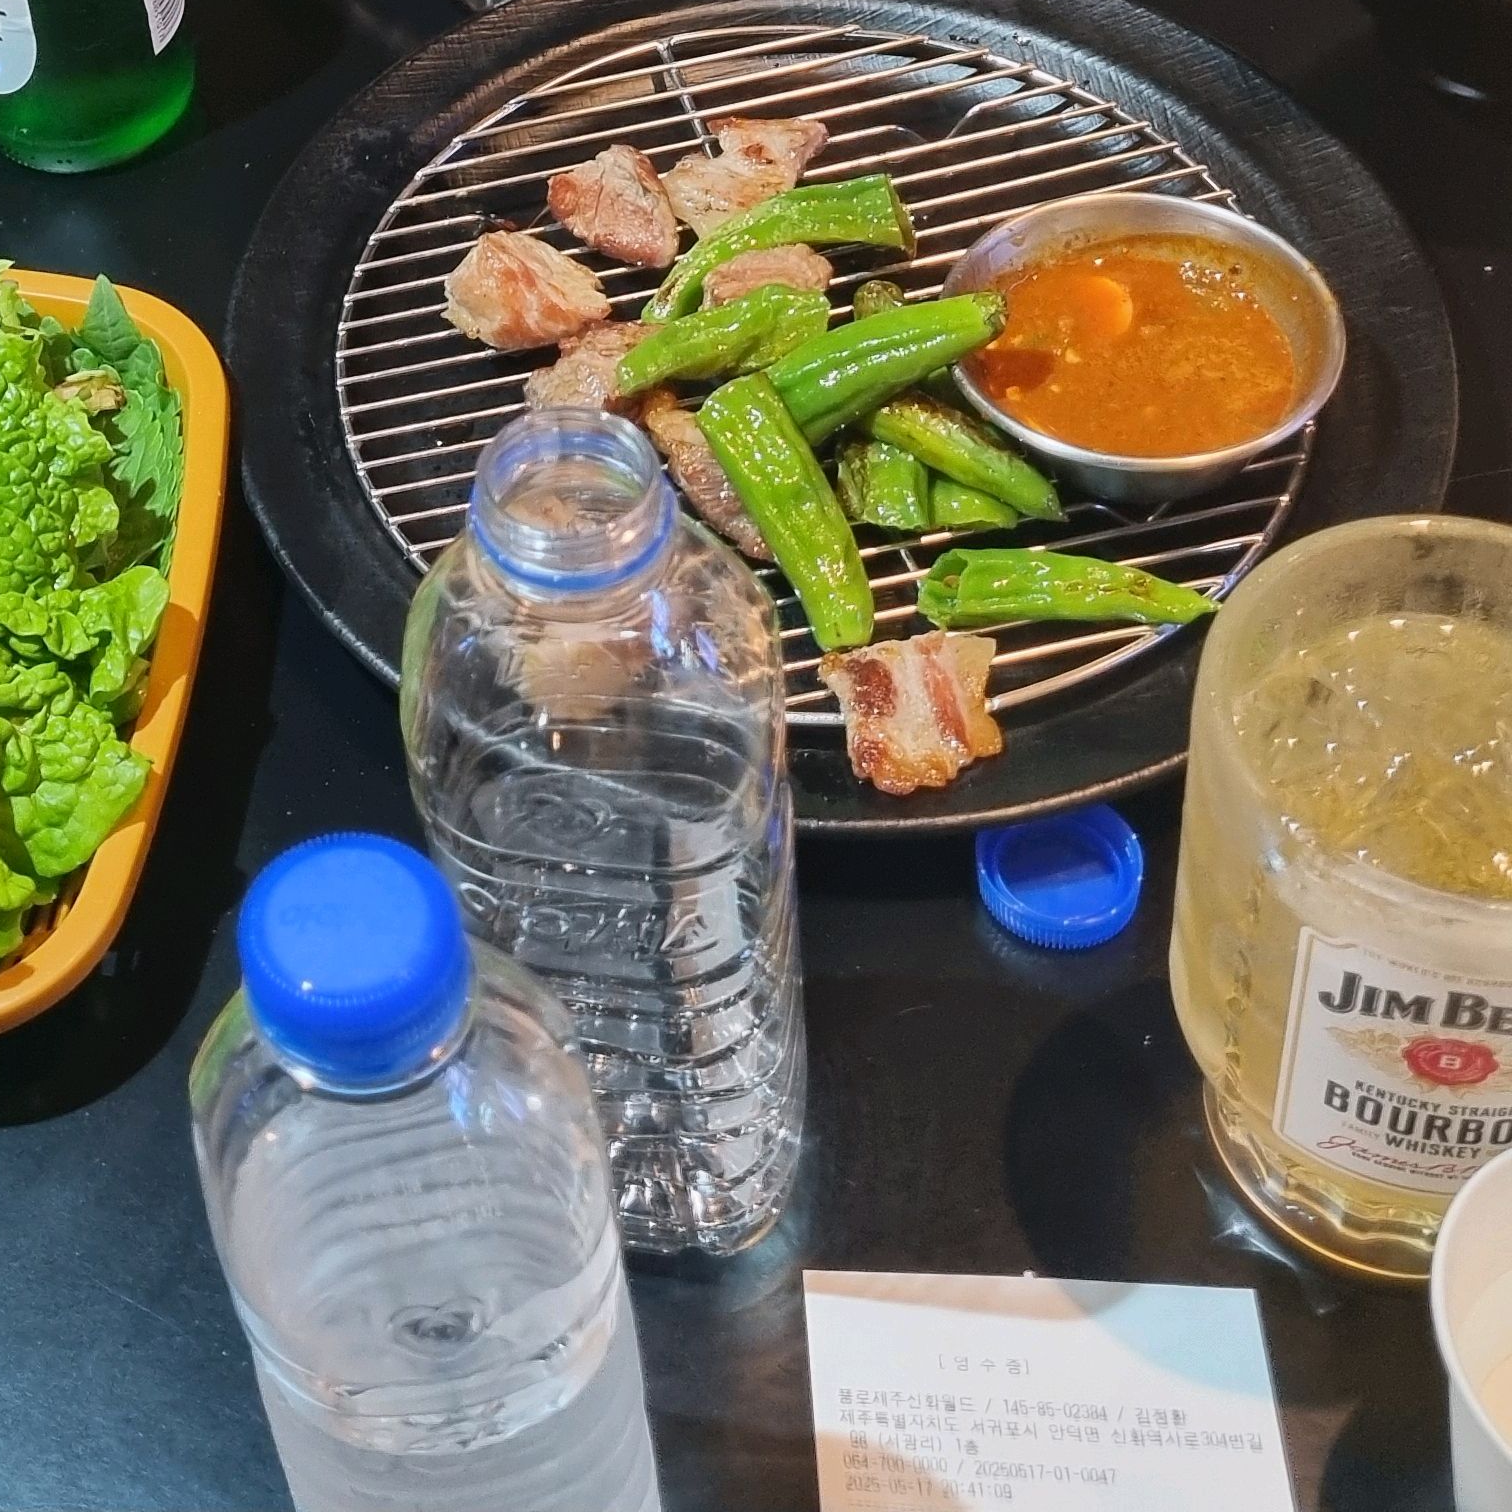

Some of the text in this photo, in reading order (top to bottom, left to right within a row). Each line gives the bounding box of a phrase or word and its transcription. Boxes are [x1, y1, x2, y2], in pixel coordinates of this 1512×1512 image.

[1318, 970, 1435, 1025] JIM
[1354, 1079, 1441, 1113] KENTUCKY
[1385, 1133, 1482, 1159] WHISKEY
[970, 1418, 1039, 1440] 서귀포시
